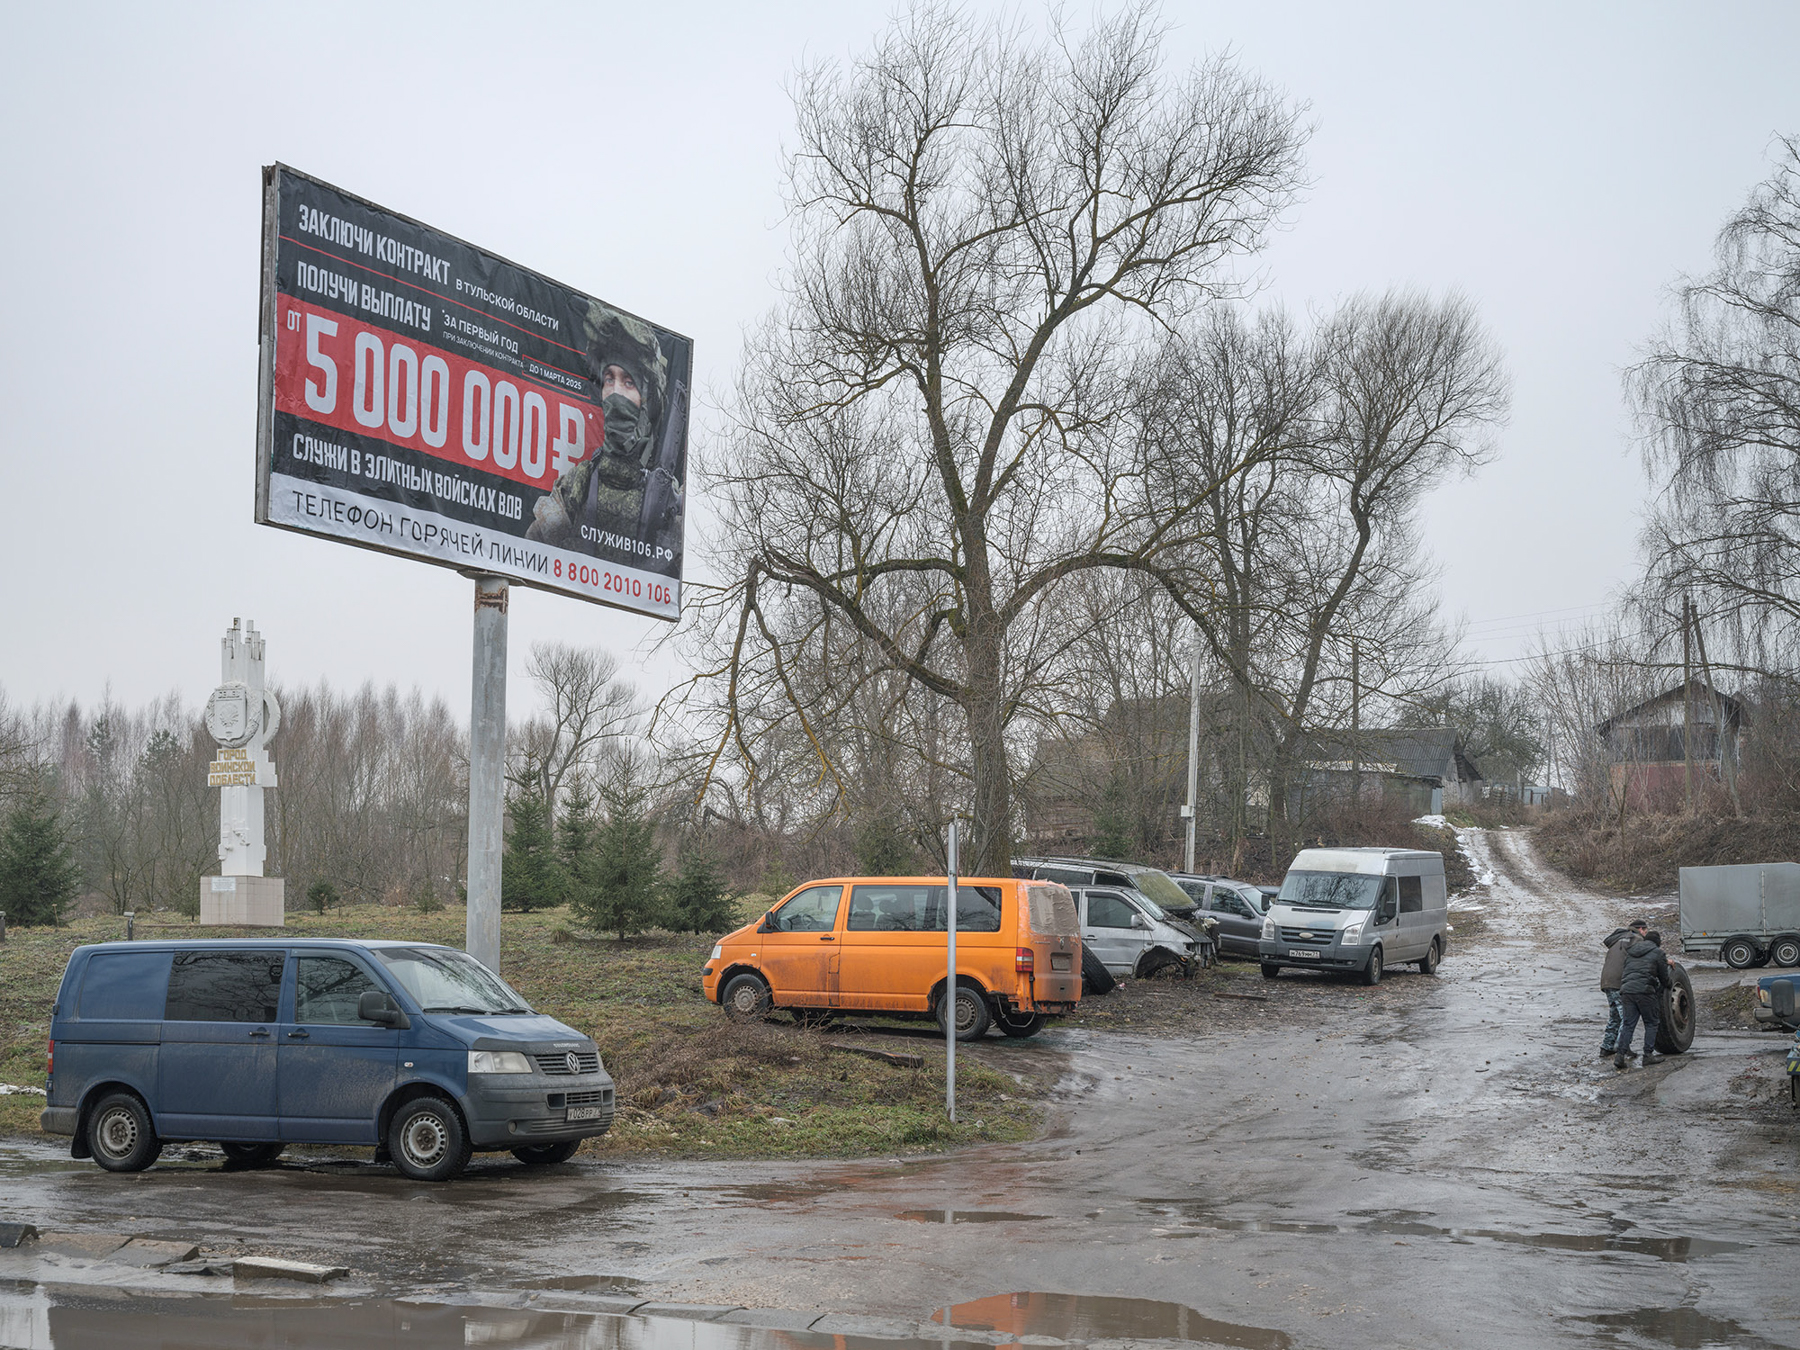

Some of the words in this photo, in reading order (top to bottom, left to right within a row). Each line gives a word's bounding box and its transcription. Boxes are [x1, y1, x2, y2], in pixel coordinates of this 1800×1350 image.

[299, 204, 373, 256] ЗАКЛЮЧИ
[376, 233, 450, 286] КОНТРАКТ
[298, 261, 358, 306] ПОЛУЧИ
[361, 284, 431, 332] ВЫПЛАТУ
[456, 279, 463, 291] В
[464, 281, 515, 313] ТУЛЬСКОЙ
[516, 304, 559, 331] ОБЛАСТИ
[443, 331, 456, 342] ПРИ
[456, 336, 495, 357] ЗАКЛЮЧЕНИИ
[495, 351, 524, 369] КОНТРАКТА
[459, 319, 499, 346] ПЕРВЫЙ
[501, 336, 519, 355] ГОД
[287, 310, 301, 332] ОТ
[304, 312, 339, 415] 5
[353, 331, 449, 448] 000
[529, 363, 539, 374] ДО
[544, 369, 565, 385] МАРТА
[566, 378, 582, 390] 2025
[293, 433, 348, 472] СЛУЖИ
[351, 449, 361, 476] В
[365, 453, 433, 495] ЭЛИТНЫХ
[435, 473, 497, 513] ВОЙСКАХ
[498, 491, 523, 520] ВДВ
[292, 490, 393, 534] ТЕЛЕФОН
[400, 517, 483, 557] ГОРЯЧЕЙ
[489, 542, 548, 574] ЛИНИИ
[553, 559, 562, 578] 8
[568, 562, 599, 587] 800
[603, 572, 641, 597] 2010
[647, 583, 671, 605] 106
[581, 524, 673, 562] СЛУЖИВ106.РФ
[218, 749, 247, 761] ГОРОД
[209, 773, 256, 786] ДОБЛЕСТИ
